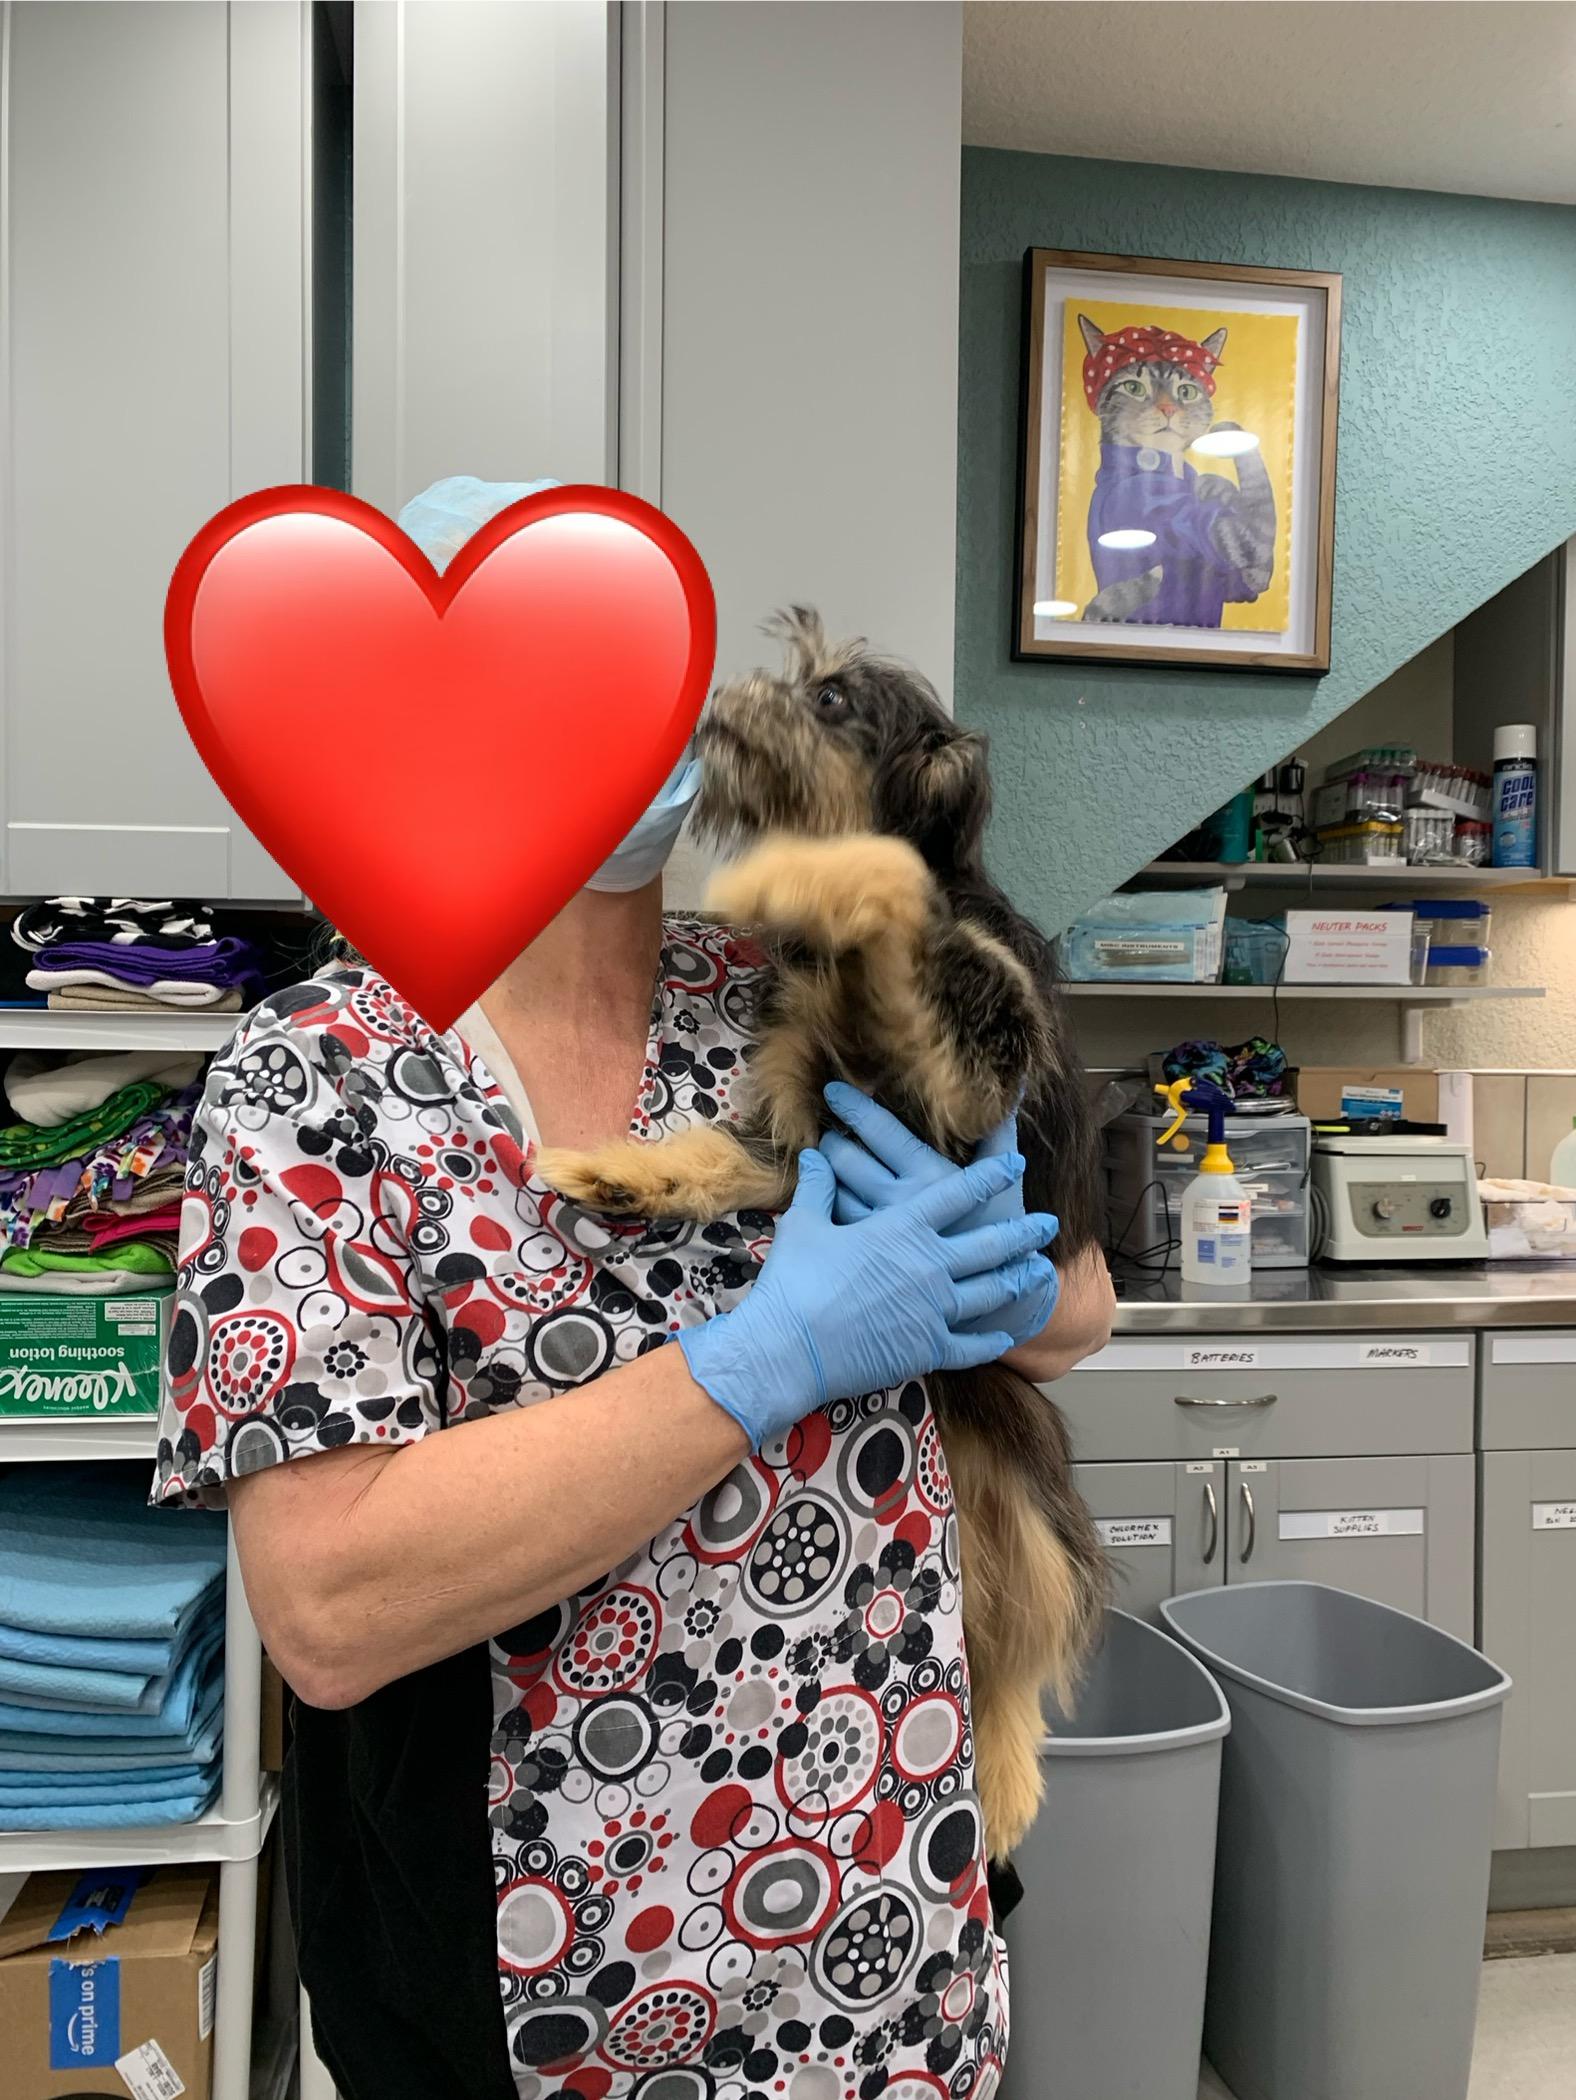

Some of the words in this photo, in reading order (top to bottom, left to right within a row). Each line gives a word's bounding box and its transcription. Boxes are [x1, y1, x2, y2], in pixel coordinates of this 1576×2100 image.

[1312, 921, 1351, 931] NEUTER
[1355, 922, 1388, 932] PACKS
[9, 1347, 55, 1361] lotion
[59, 1345, 125, 1361] soothing
[1190, 1350, 1254, 1364] BATTERIES
[1366, 1347, 1419, 1360] MARKERS
[0, 1361, 136, 1410] Kleenex
[1340, 1515, 1376, 1524] KITTEN
[1333, 1524, 1379, 1534] SUPPLIES
[1111, 1533, 1157, 1544] SOLUTION
[81, 1981, 95, 2001] on
[78, 2005, 99, 2056] prime
